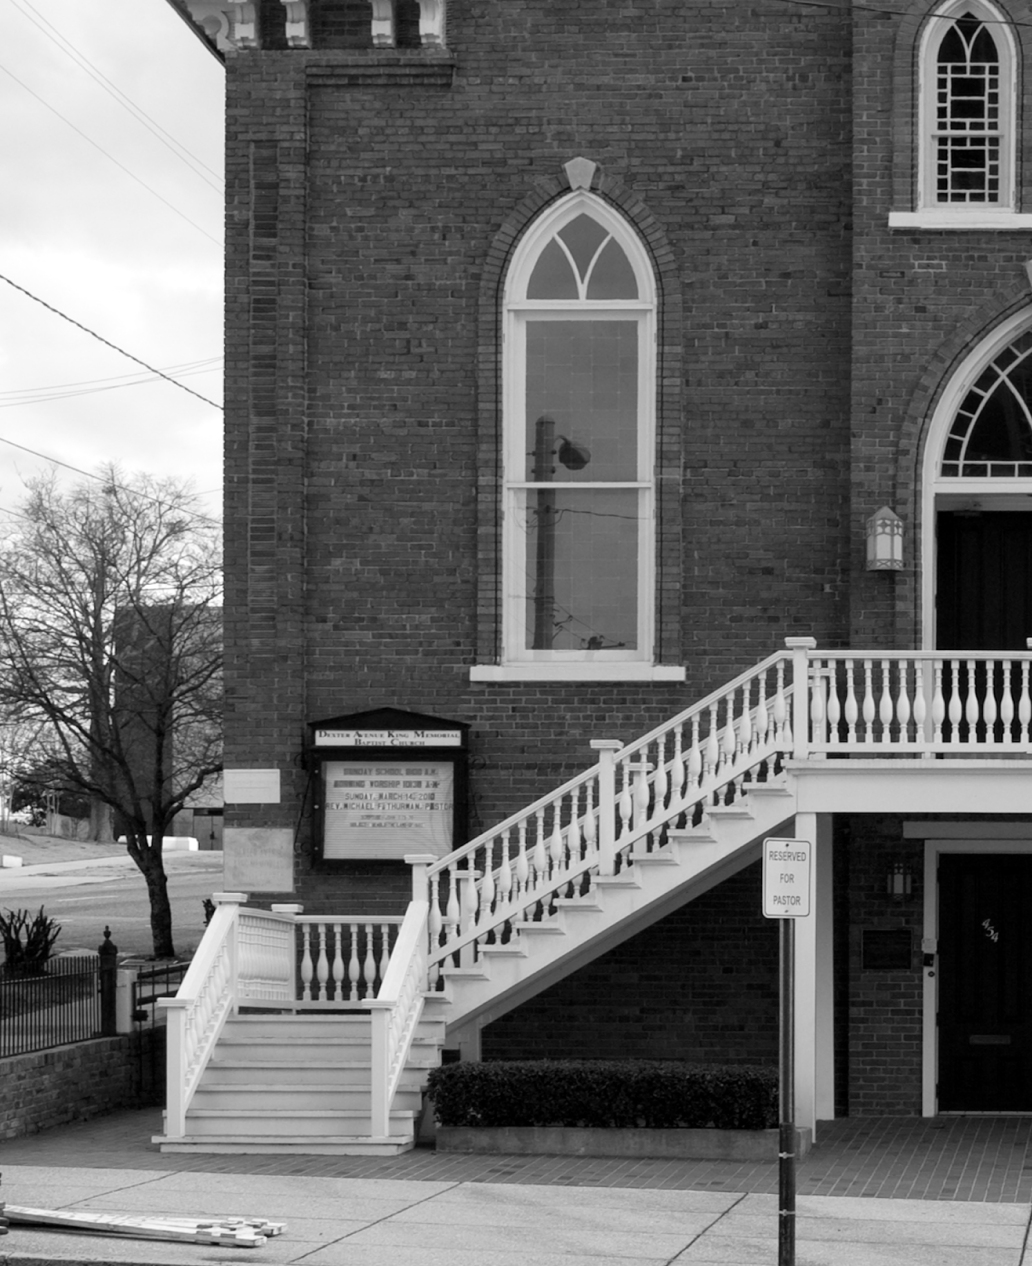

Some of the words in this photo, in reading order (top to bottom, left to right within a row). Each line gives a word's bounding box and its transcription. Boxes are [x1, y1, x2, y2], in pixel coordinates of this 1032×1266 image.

[378, 792, 402, 801] MARCH
[769, 851, 806, 862] RESERVED
[779, 873, 794, 883] FOR
[773, 895, 801, 906] PASTOR
[981, 918, 999, 943] 454
